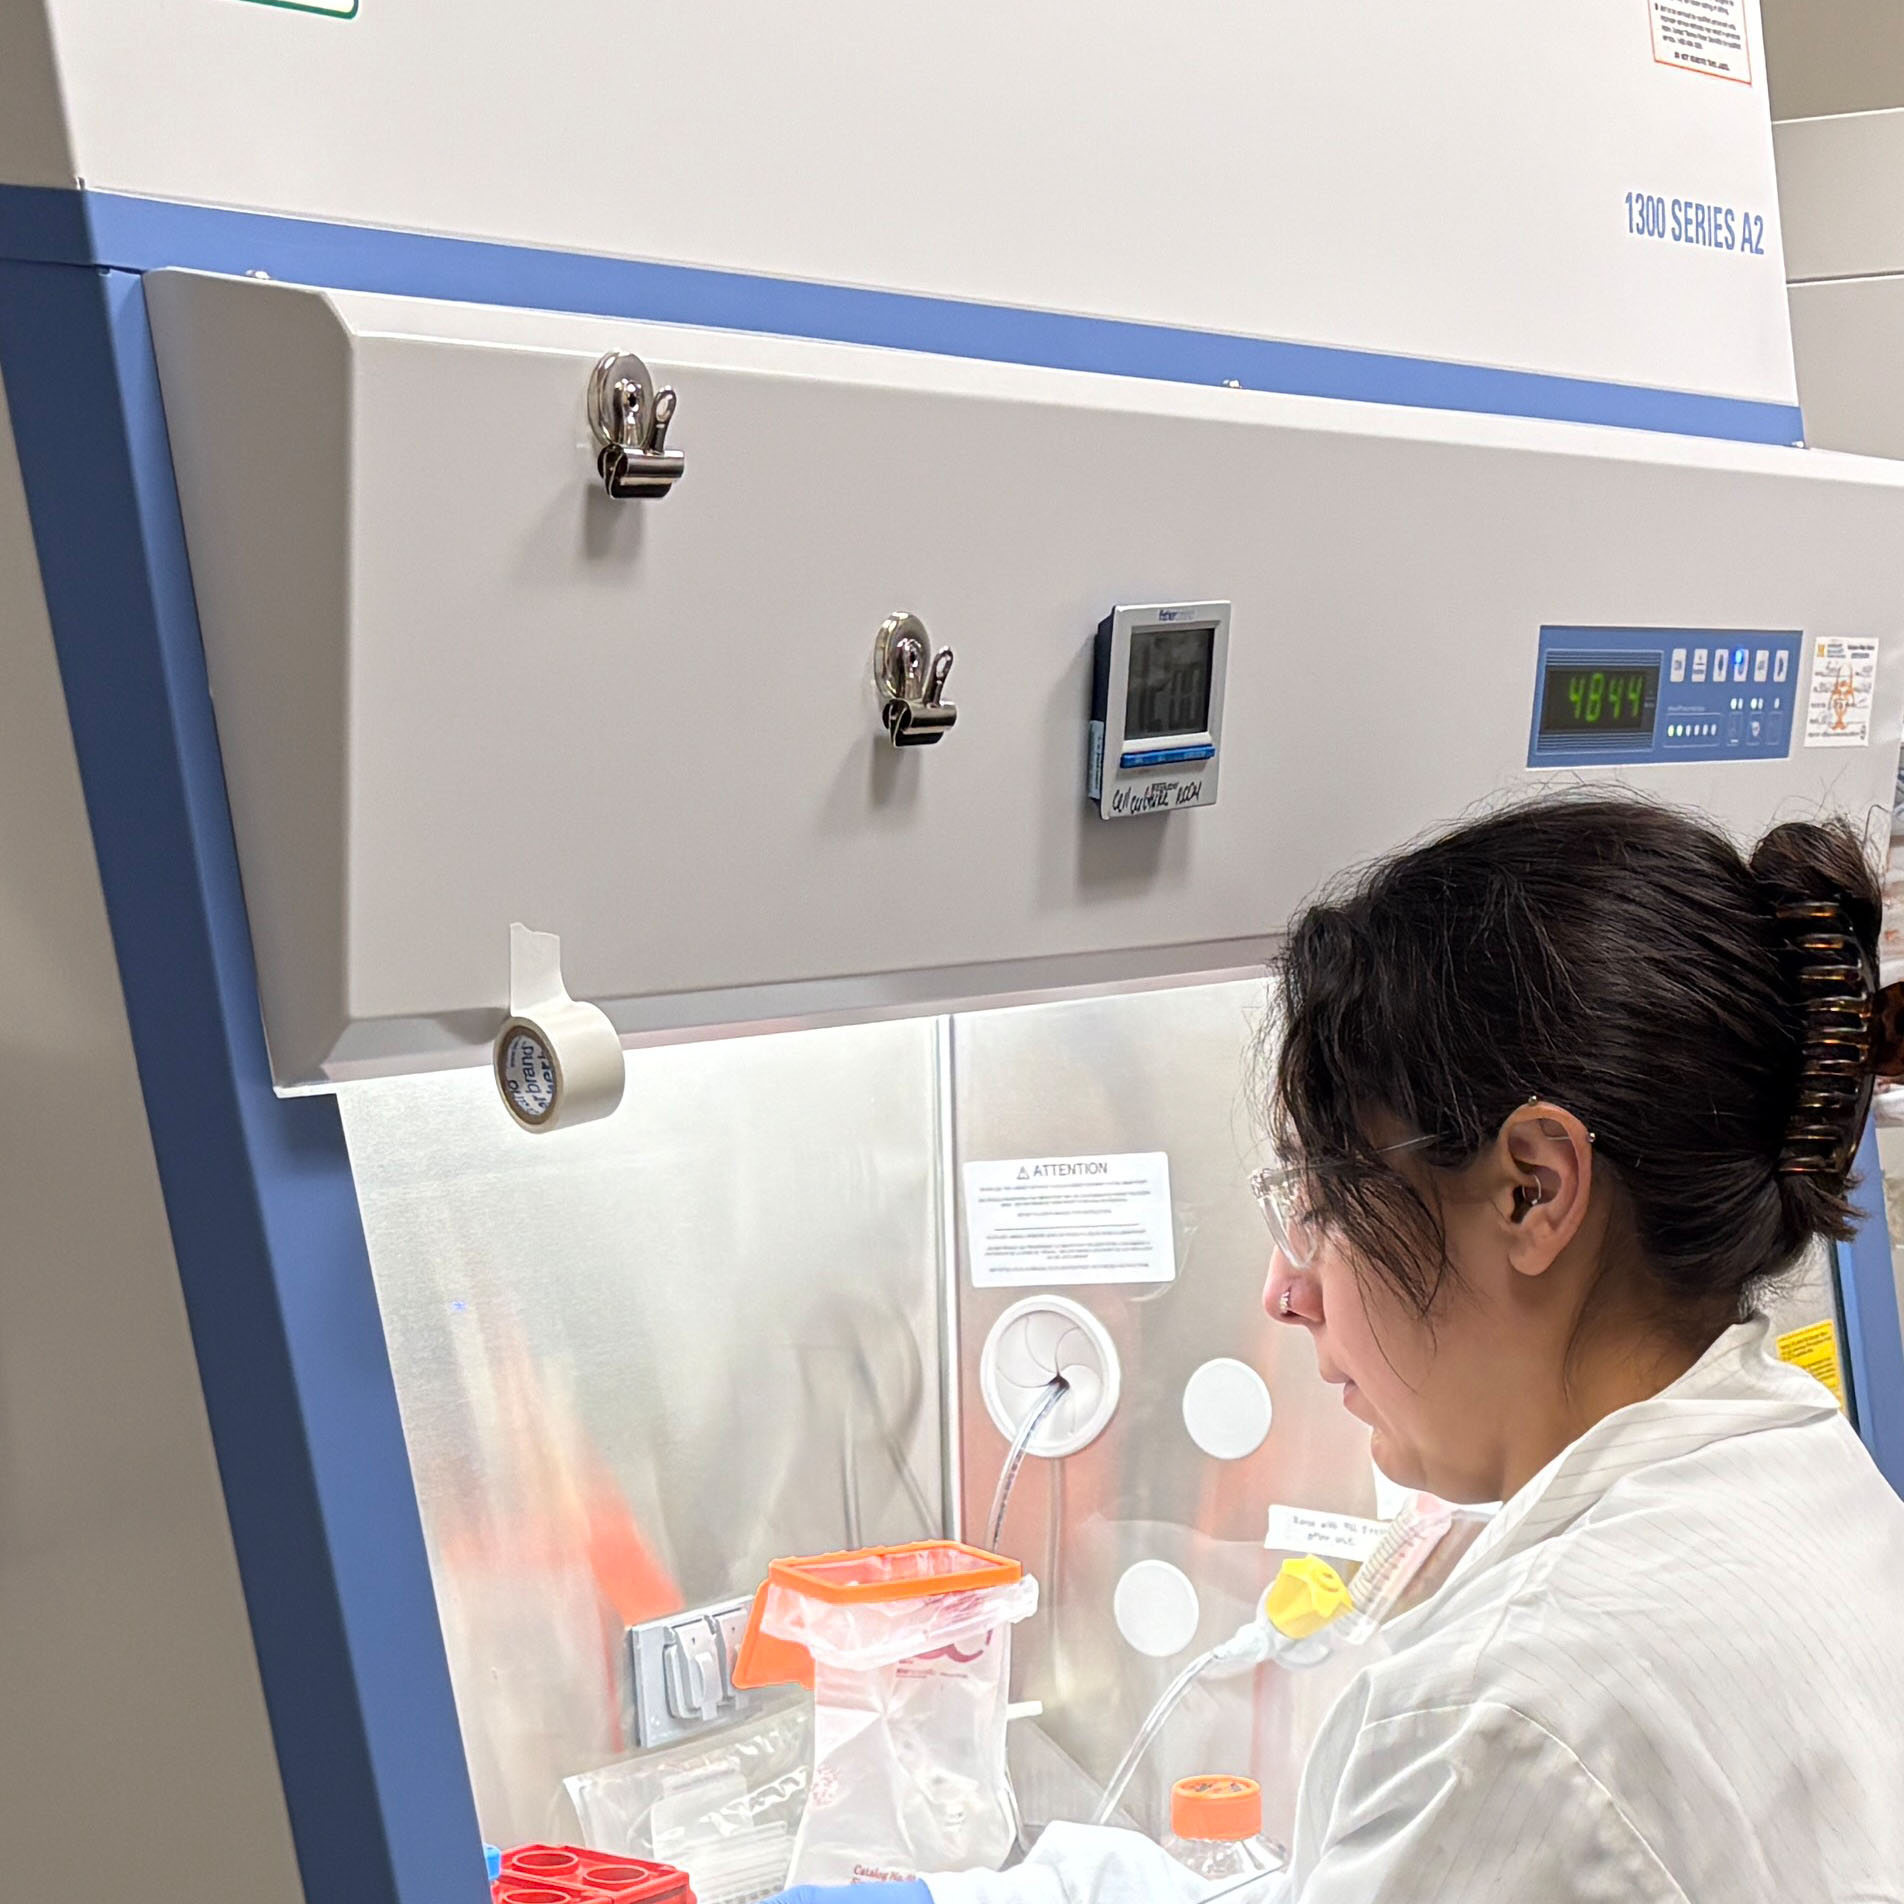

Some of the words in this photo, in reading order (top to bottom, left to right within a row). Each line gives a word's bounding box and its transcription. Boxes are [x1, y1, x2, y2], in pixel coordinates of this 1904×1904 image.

[1625, 191, 1666, 239] 1300
[1671, 198, 1736, 250] SERIES
[1740, 211, 1765, 255] A2
[1033, 1162, 1108, 1177] ATTENTION
[853, 1863, 888, 1881] Catalog
